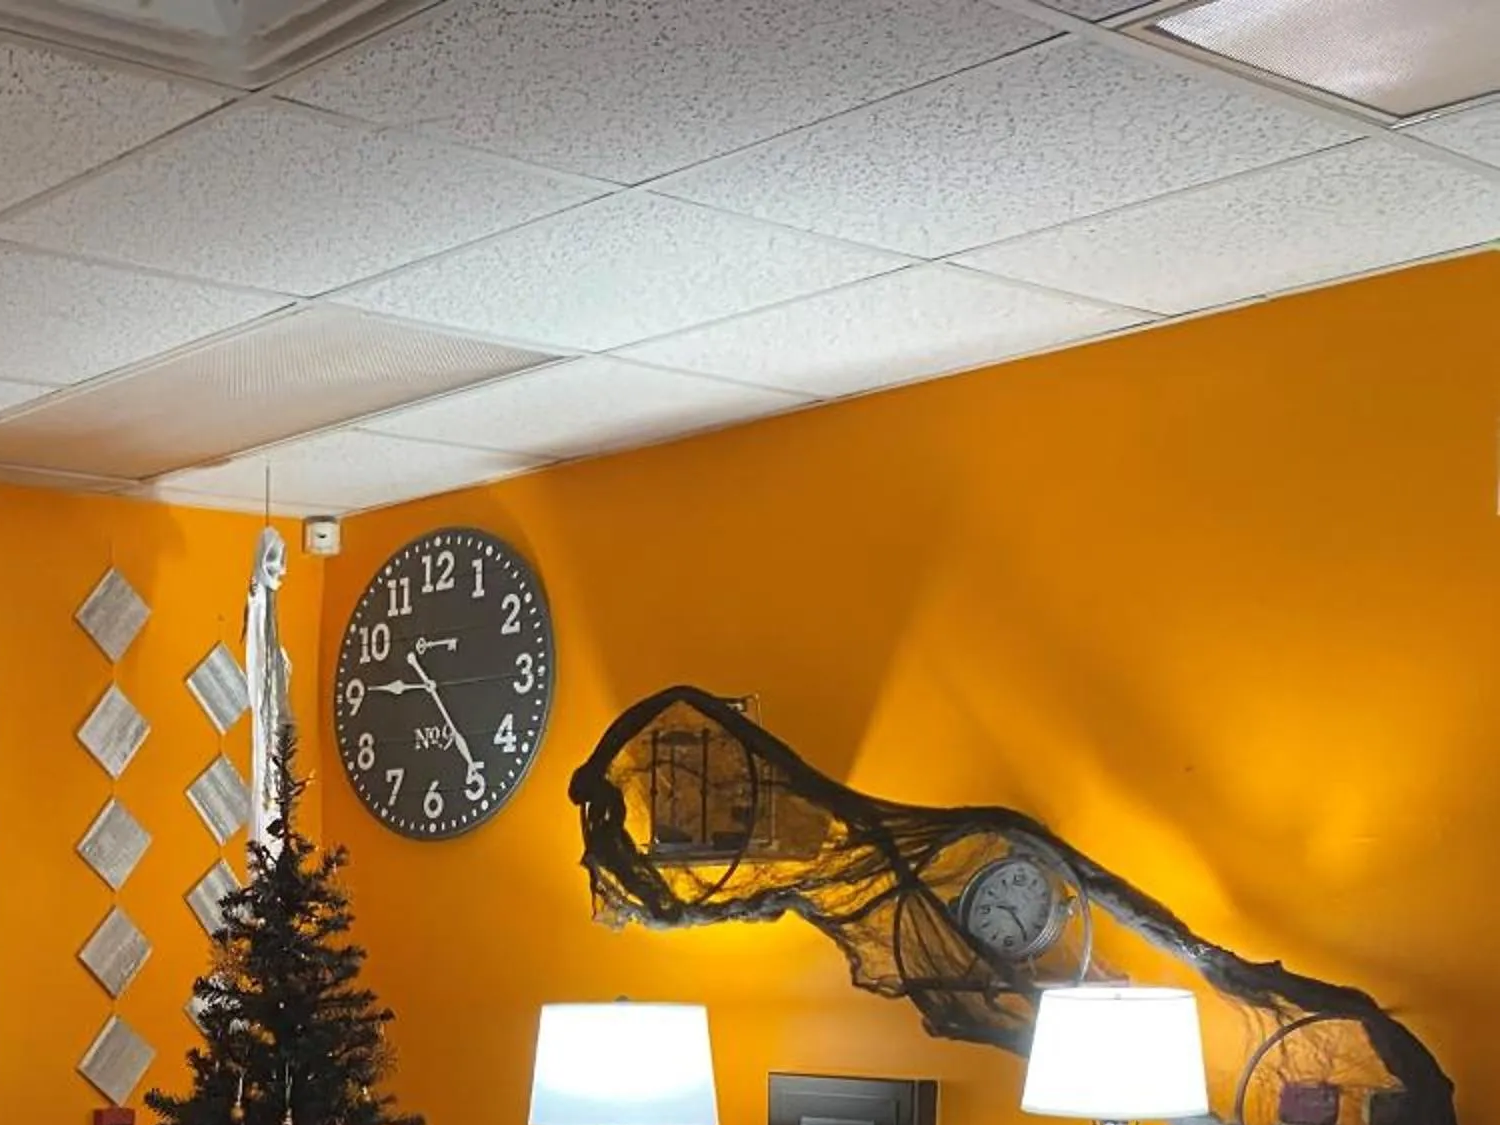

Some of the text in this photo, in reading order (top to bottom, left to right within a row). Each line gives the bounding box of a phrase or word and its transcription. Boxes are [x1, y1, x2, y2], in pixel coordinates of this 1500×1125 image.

[421, 550, 456, 593] 12
[472, 558, 485, 598] 1
[387, 577, 412, 617] 11
[501, 593, 521, 635] 2
[359, 623, 391, 664] 10
[513, 653, 534, 694] 3
[346, 677, 365, 716] 9
[357, 732, 376, 771] 8
[493, 713, 517, 753] 4
[385, 767, 404, 806] 7
[423, 780, 444, 819] 6
[465, 761, 486, 801] 5
